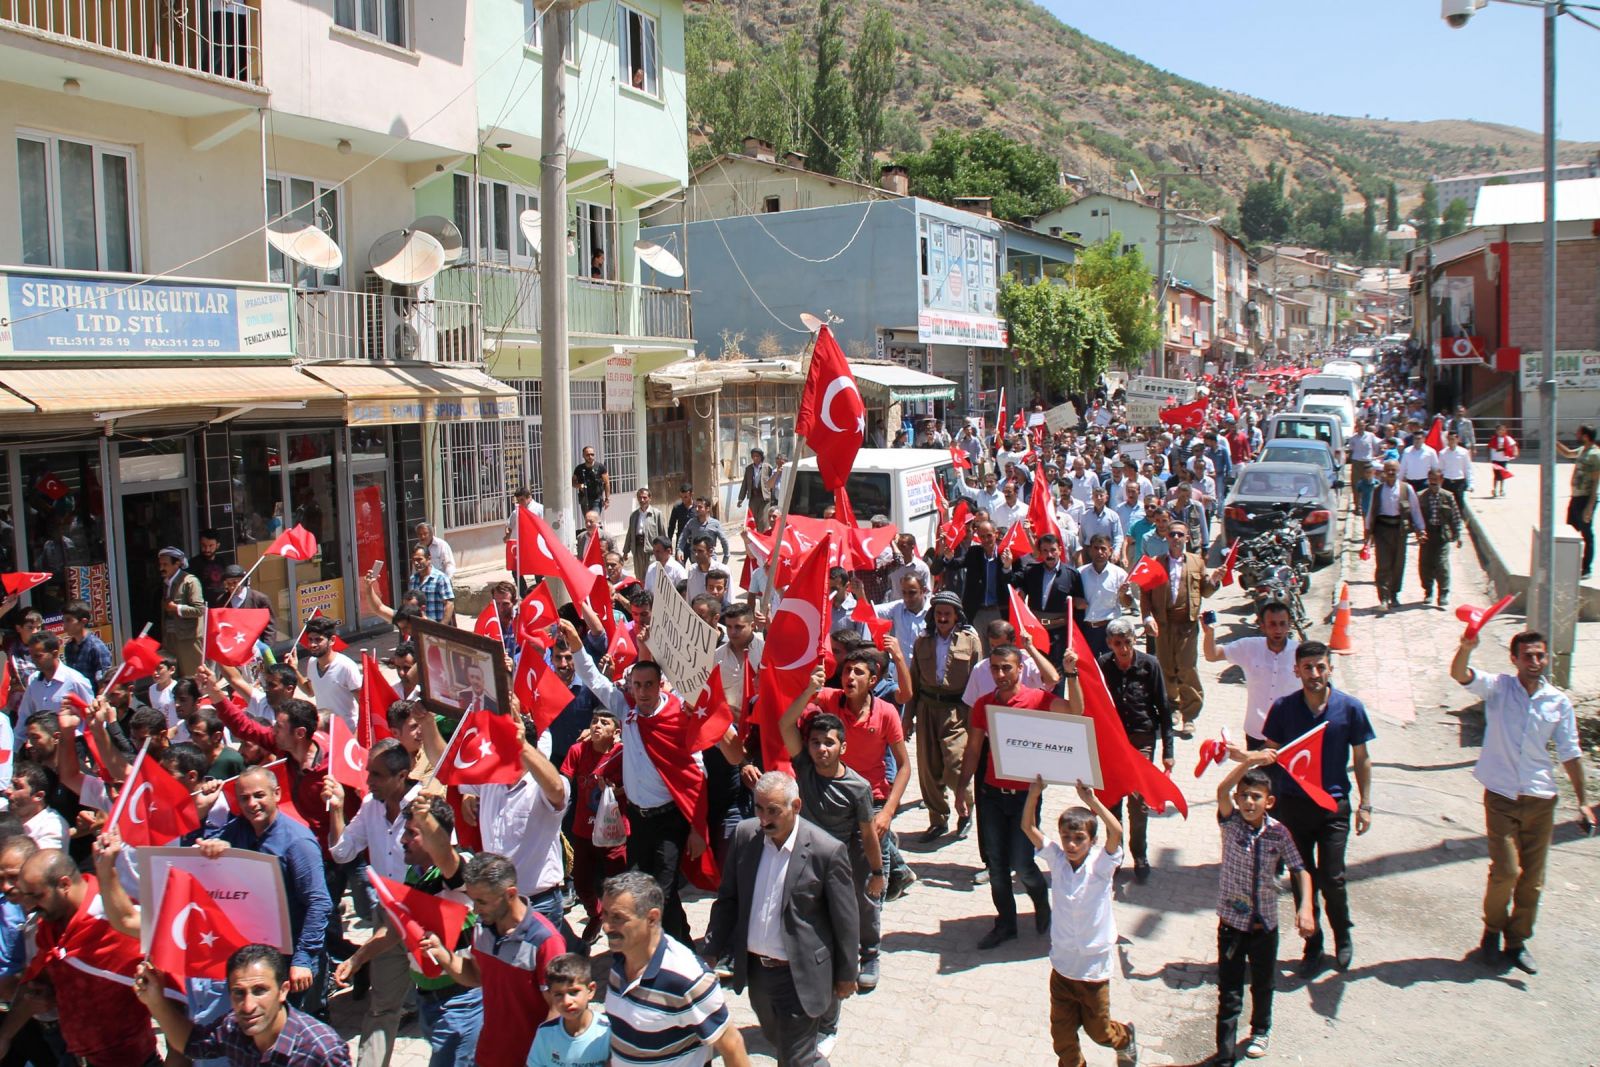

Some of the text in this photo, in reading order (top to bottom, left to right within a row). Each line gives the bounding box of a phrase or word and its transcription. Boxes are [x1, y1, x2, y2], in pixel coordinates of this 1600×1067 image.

[22, 282, 229, 314] SERHAT TURGUTLAR
[48, 336, 96, 346] TEL:311
[100, 337, 113, 346] 26
[118, 338, 130, 346] 19
[144, 338, 188, 347] FAX:311
[191, 339, 205, 347] 23
[302, 592, 337, 605] MOPAK
[1044, 743, 1074, 753] HAYIR
